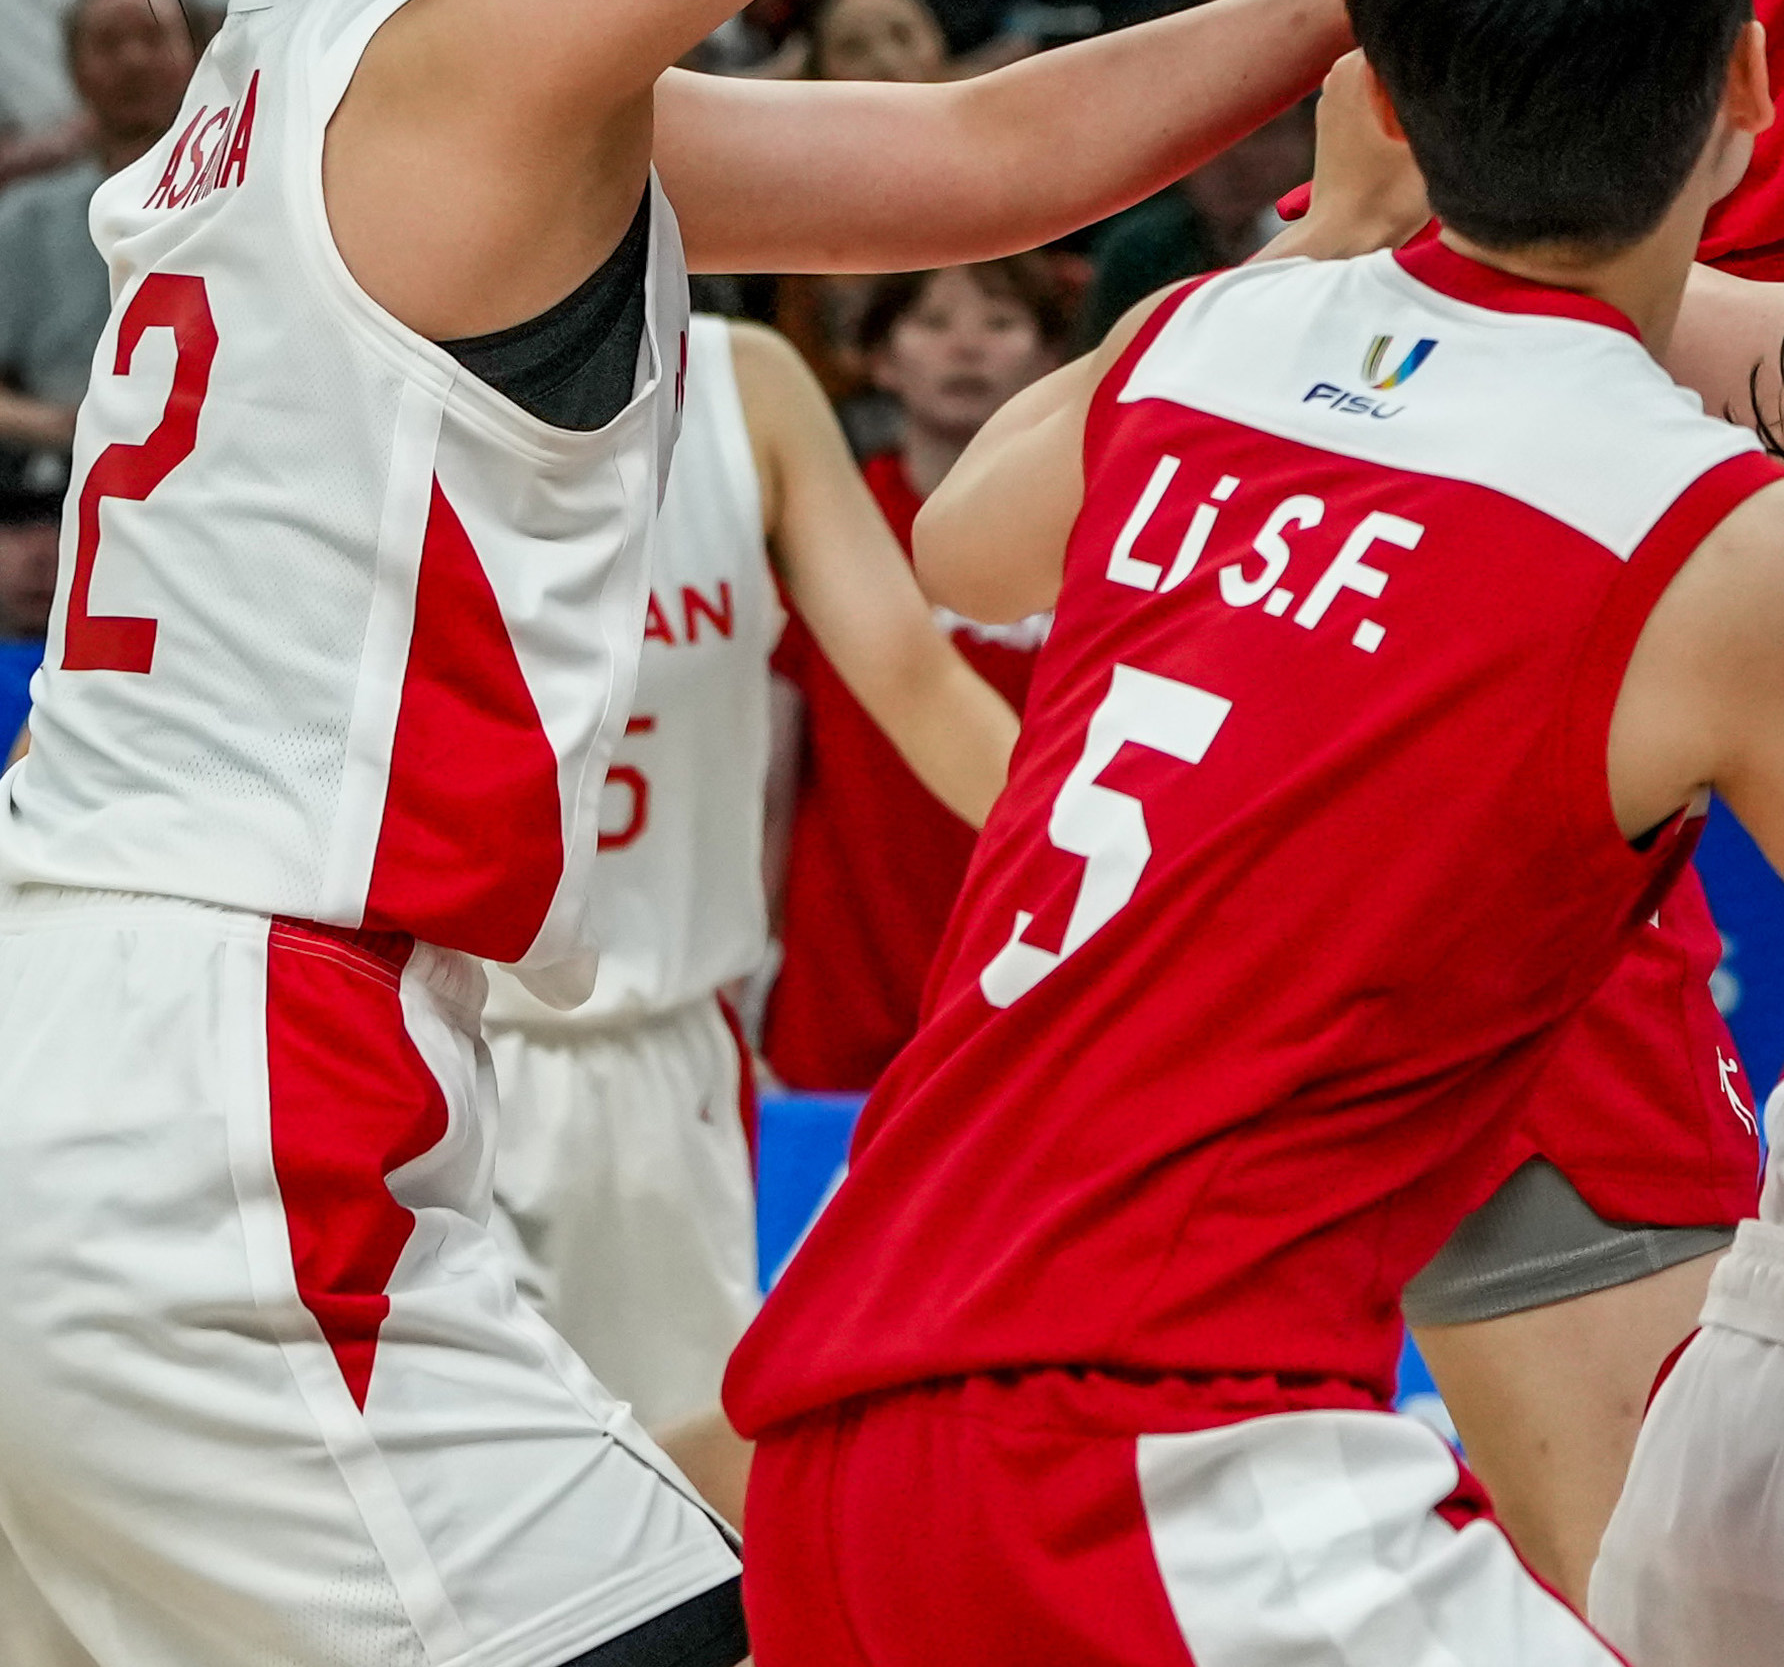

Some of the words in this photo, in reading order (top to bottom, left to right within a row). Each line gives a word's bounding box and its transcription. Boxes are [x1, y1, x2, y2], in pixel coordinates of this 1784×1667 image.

[60, 271, 220, 675] 2
[1302, 382, 1407, 419] FISU
[979, 662, 1234, 1009] 5
